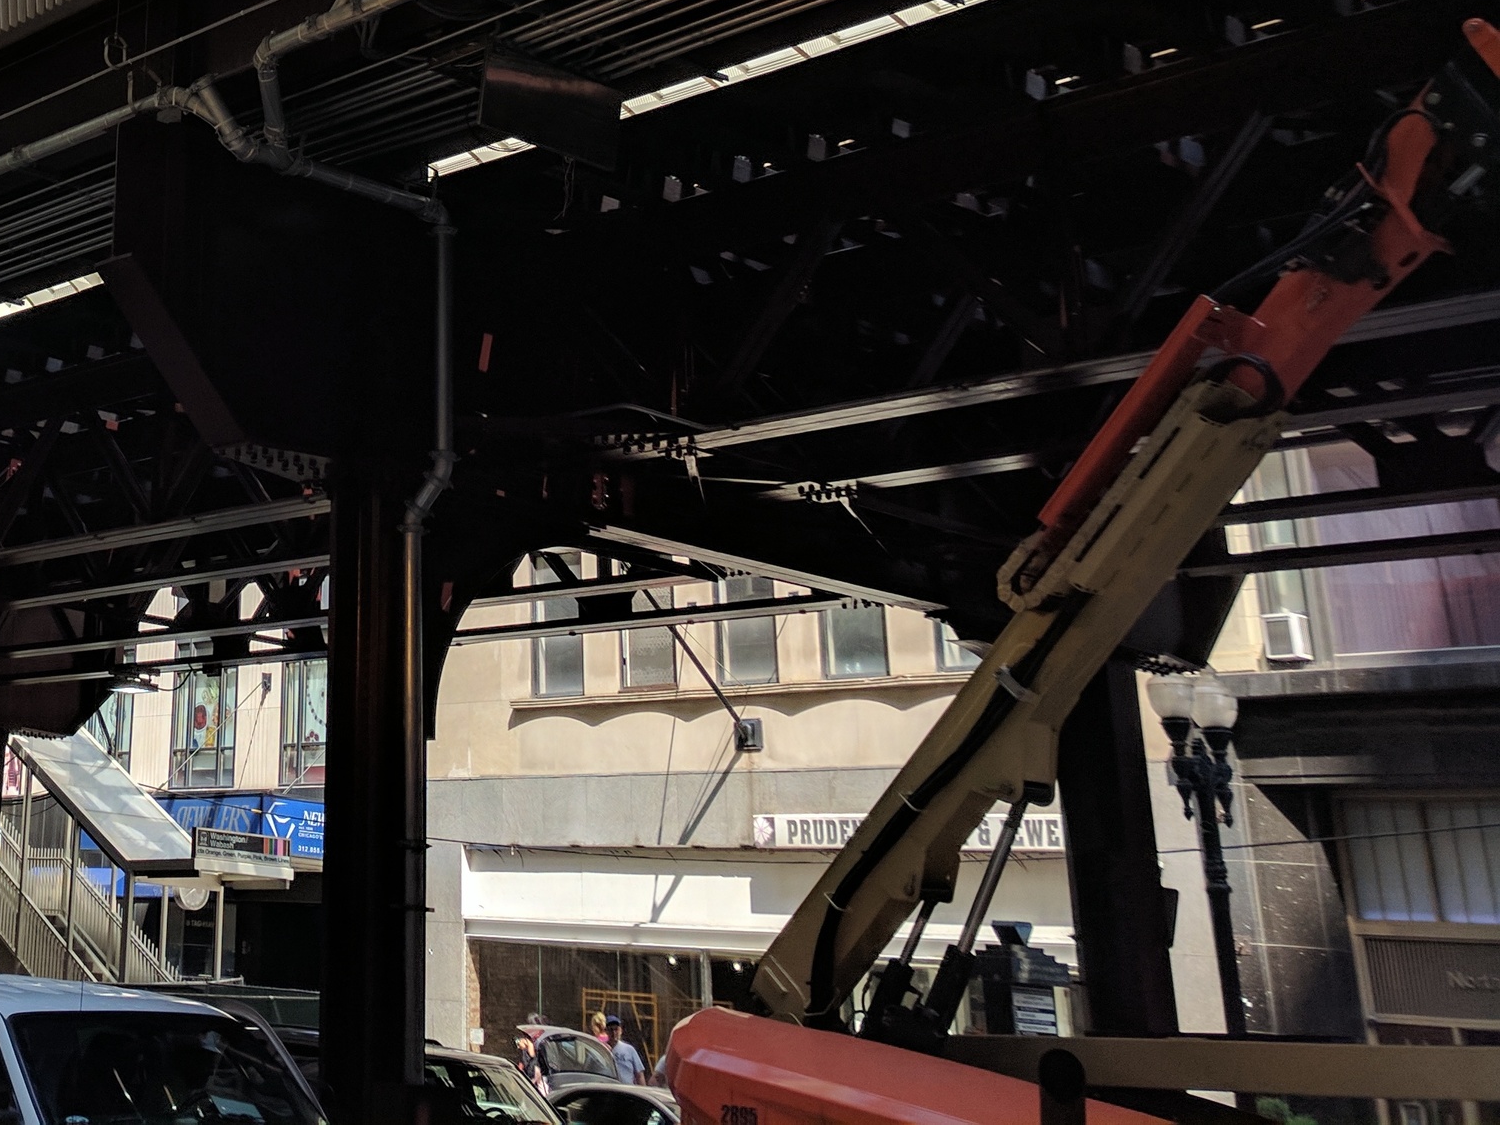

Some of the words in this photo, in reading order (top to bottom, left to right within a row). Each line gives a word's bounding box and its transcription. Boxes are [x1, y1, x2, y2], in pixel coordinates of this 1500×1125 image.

[210, 831, 249, 845] Washington/
[209, 839, 235, 850] Wabash
[206, 849, 222, 858] Orange,
